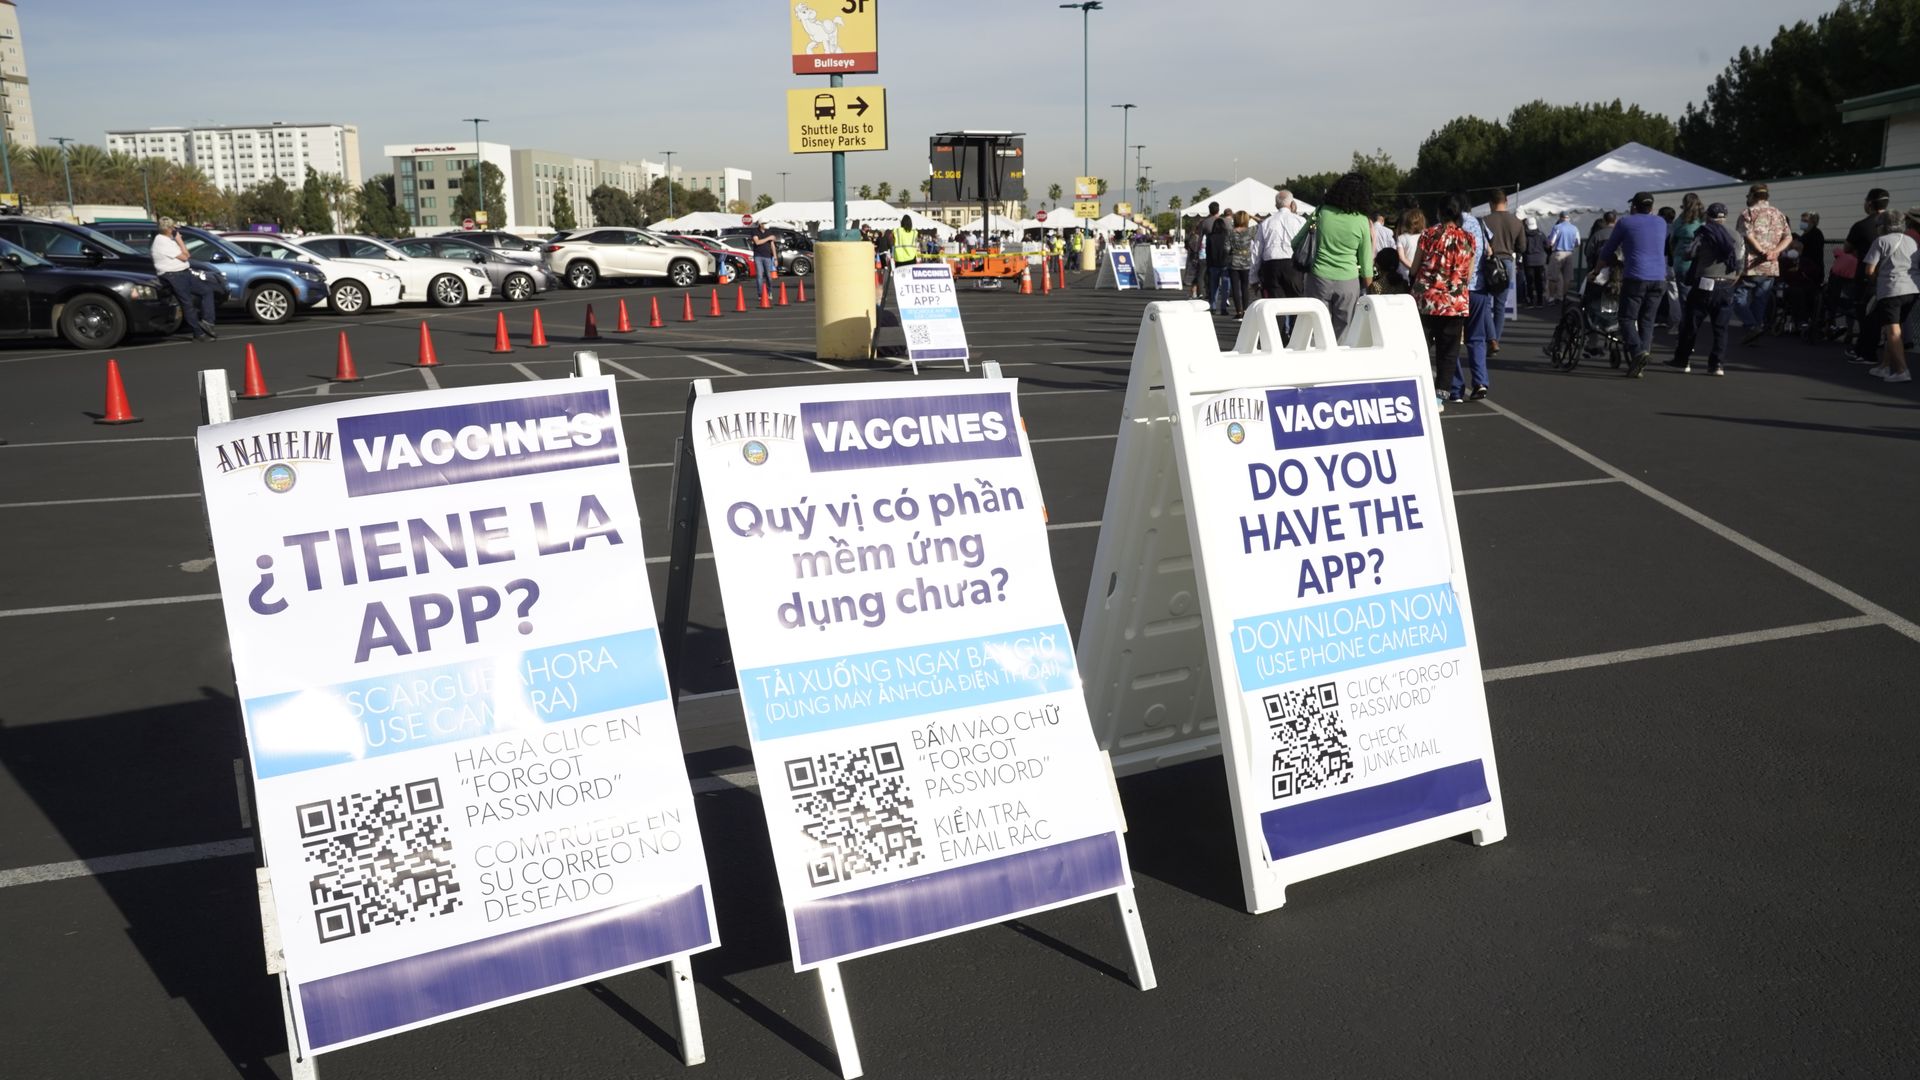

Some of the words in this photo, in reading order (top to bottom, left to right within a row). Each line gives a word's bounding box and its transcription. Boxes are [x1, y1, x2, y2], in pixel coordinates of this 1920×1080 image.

[814, 58, 855, 69] Bullseye
[801, 124, 838, 136] Shuttle
[841, 123, 860, 134] Bus
[862, 122, 874, 133] to
[802, 136, 836, 149] Disney
[838, 135, 867, 146] Parks
[899, 284, 936, 296] ¿TIENE
[938, 283, 952, 293] LA
[912, 269, 950, 278] VACCINES
[914, 296, 940, 305] APP?
[705, 411, 798, 446] ANAHEIM
[811, 411, 1008, 452] VACCINES
[1204, 397, 1265, 427] ANAHEIM
[1275, 395, 1415, 433] VACCINES
[216, 430, 334, 473] ANAHEIM
[353, 413, 602, 473] VACCINES
[1248, 458, 1309, 501] DO
[1314, 449, 1397, 492] YOU
[726, 496, 817, 541] Quý
[825, 493, 865, 532] vị
[873, 488, 920, 524] có
[928, 477, 1025, 526] phần
[1239, 504, 1346, 554] HAVE
[1349, 494, 1424, 538] THE
[248, 506, 516, 616] ¿TIENE
[529, 494, 624, 557] LA
[792, 536, 896, 579] mềm
[907, 530, 986, 569] ứng
[1297, 548, 1385, 598] APP?
[777, 590, 887, 632] dụng
[896, 567, 1010, 614] chưa?
[354, 577, 540, 664] APP?
[1238, 601, 1387, 654] DOWNLOAD
[1390, 590, 1456, 624] NOW
[1256, 651, 1297, 680] (USE
[1300, 637, 1366, 669] PHONE
[1368, 620, 1448, 655] CAMERA)
[756, 668, 796, 699] TẢI
[799, 659, 892, 695] XUỐNG
[896, 648, 962, 678] NGAY
[1346, 674, 1390, 699] CLICK
[1392, 659, 1461, 686] "FORGOT
[1014, 704, 1060, 731] CHỮ
[1350, 685, 1436, 720] PASSWORD"
[454, 738, 538, 773] HAGA
[542, 725, 601, 754] CLIC
[606, 715, 642, 742] EN
[919, 737, 1017, 773] "FORGOT
[1358, 723, 1408, 751] CHECK
[1363, 749, 1402, 777] JUNK
[1400, 738, 1441, 763] EMAIL
[461, 755, 583, 797] "FORGOT
[925, 756, 1050, 799] PASSWORD"
[465, 774, 622, 827] PASSWORD"
[646, 808, 681, 830] EN
[988, 800, 1031, 825] TRA
[479, 867, 514, 896] SU
[521, 842, 632, 885] CORREO
[638, 830, 682, 858] NO
[940, 830, 1006, 863] EMAIL
[484, 873, 614, 922] DESEADO
